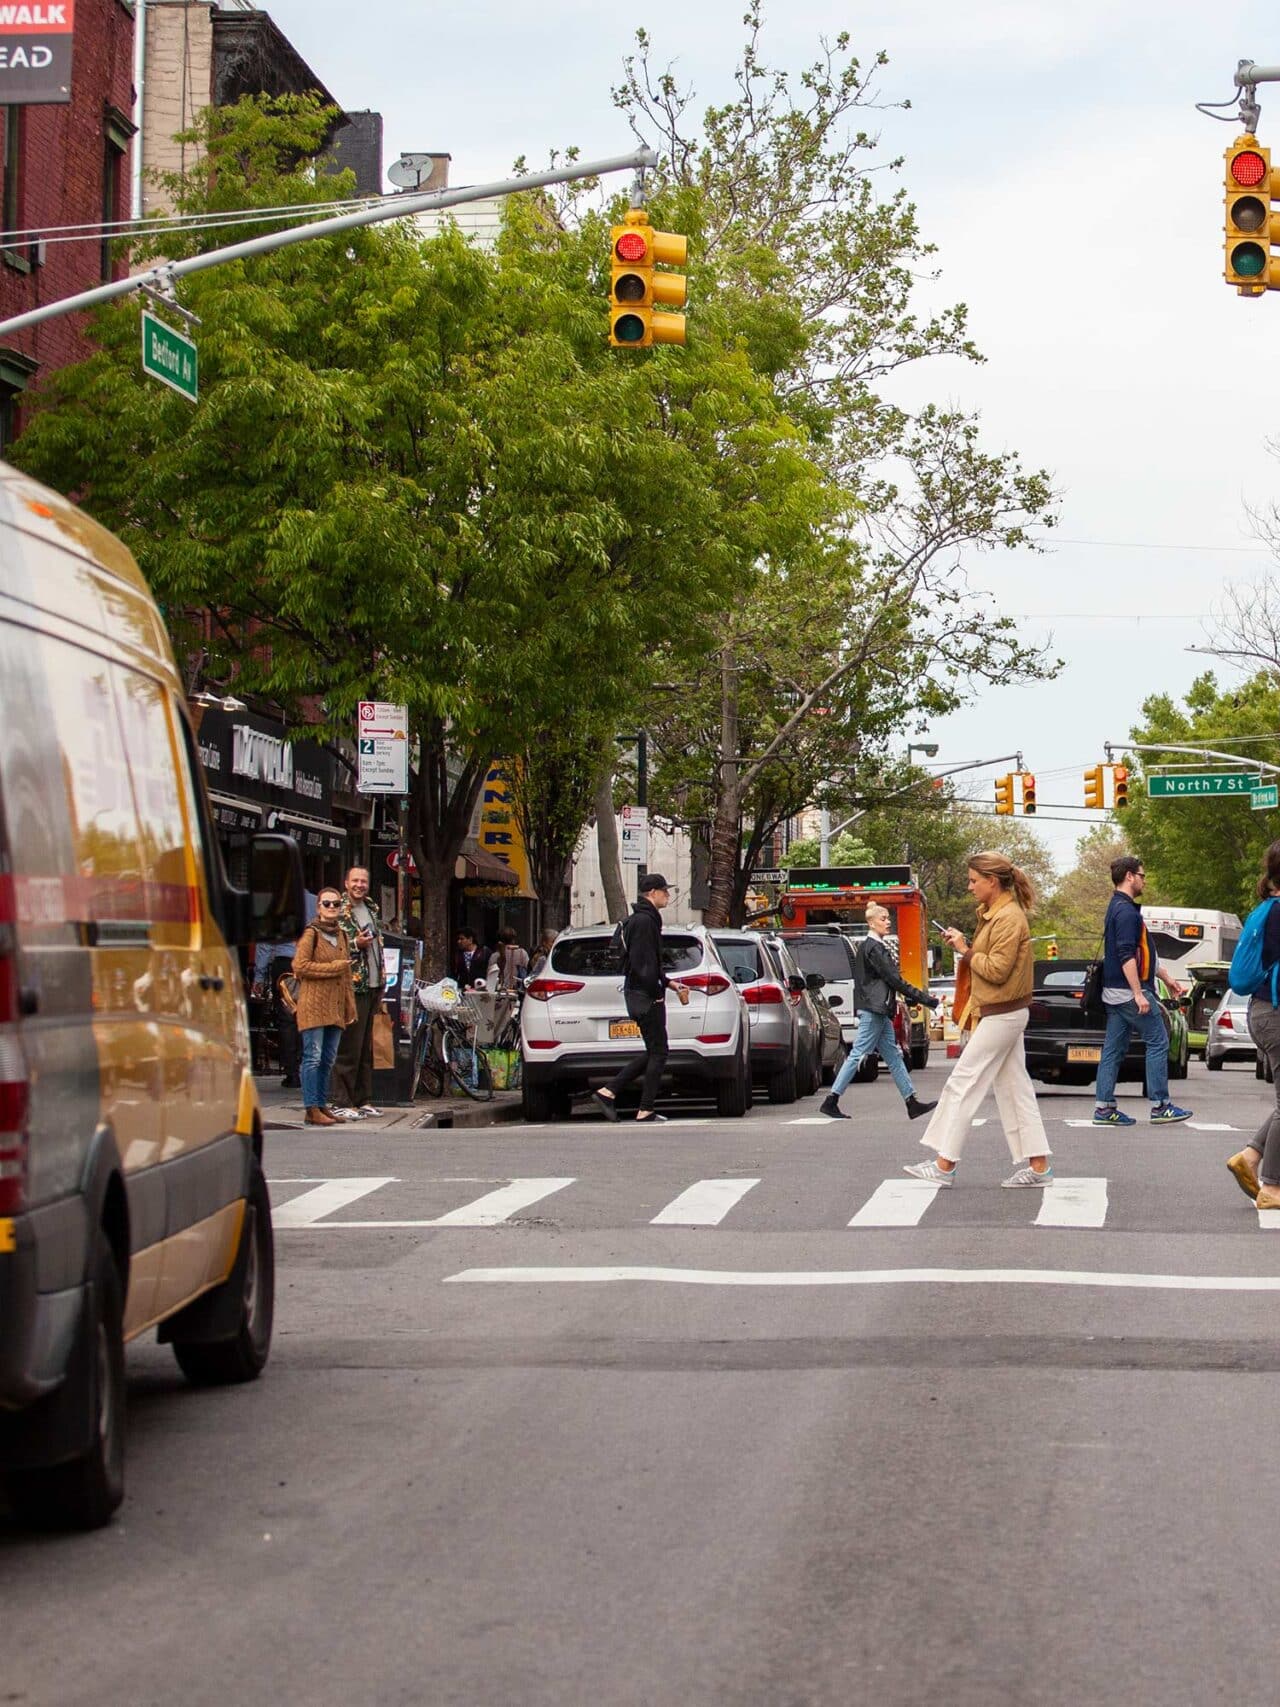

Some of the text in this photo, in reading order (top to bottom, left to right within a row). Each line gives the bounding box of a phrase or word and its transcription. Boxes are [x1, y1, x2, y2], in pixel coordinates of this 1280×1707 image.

[0, 46, 53, 68] EAD
[152, 331, 179, 375] Bedford
[363, 740, 371, 753] 2
[1165, 779, 1244, 791] North 7 St
